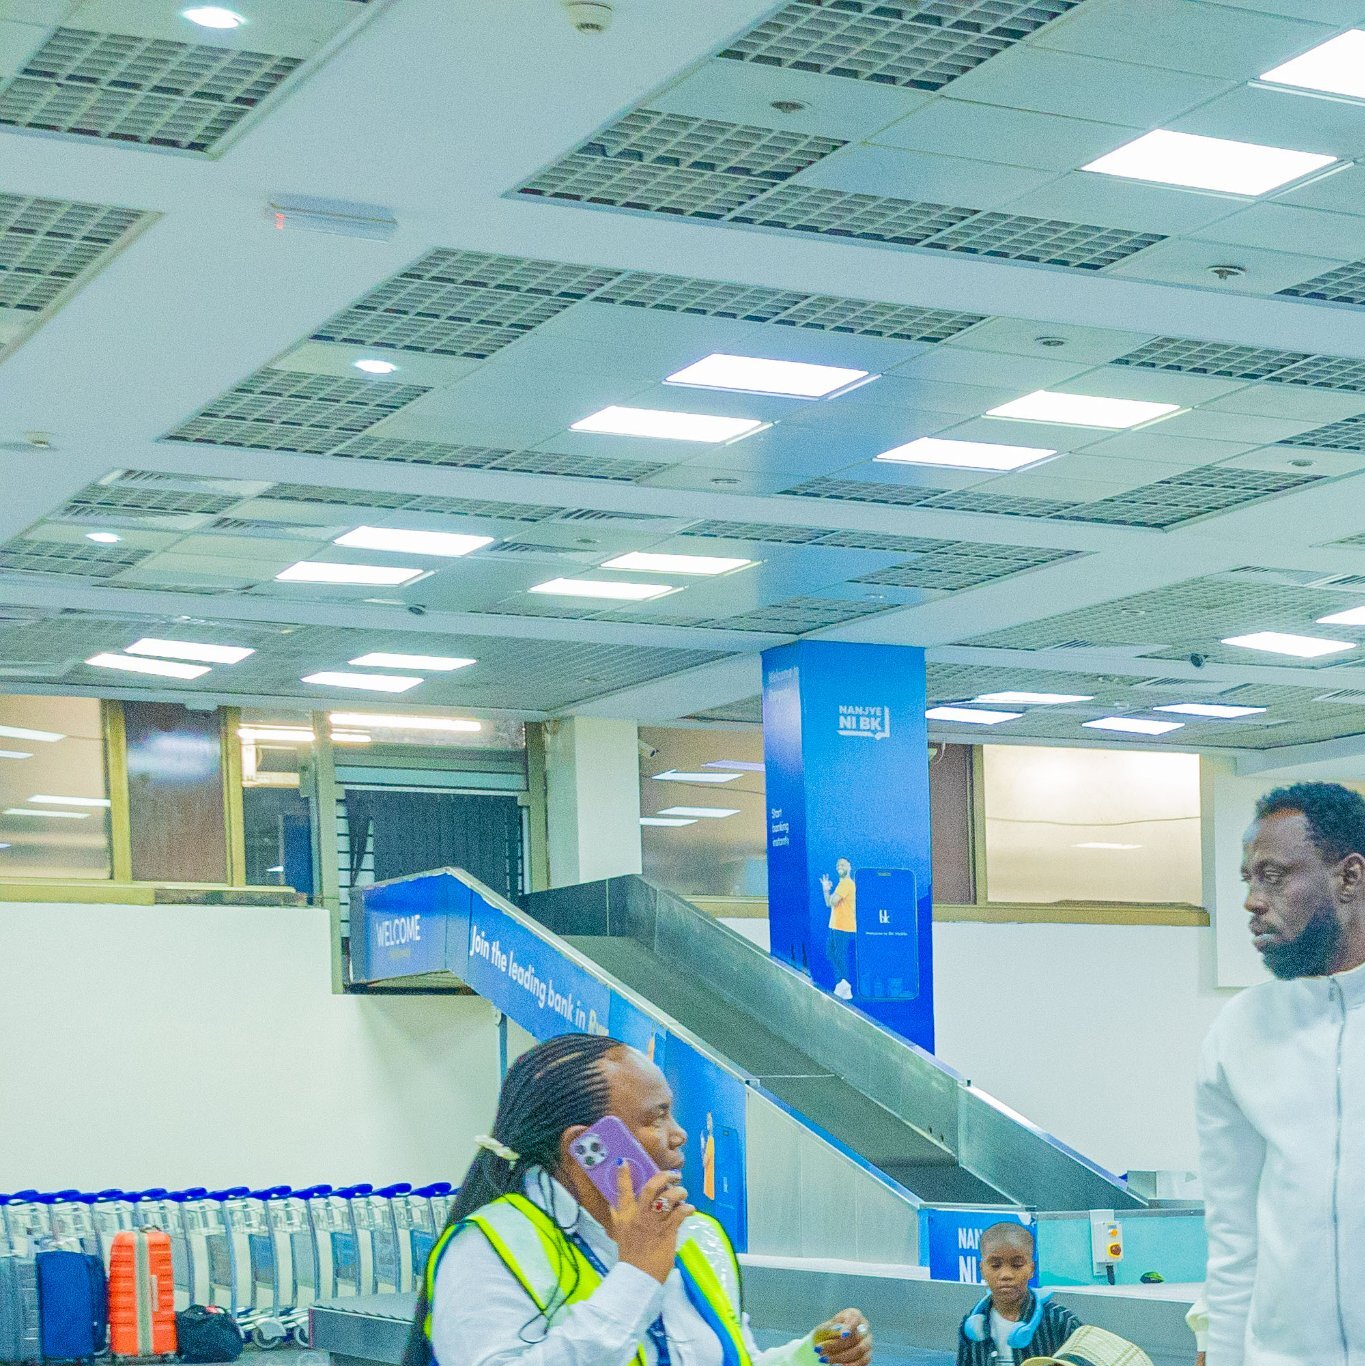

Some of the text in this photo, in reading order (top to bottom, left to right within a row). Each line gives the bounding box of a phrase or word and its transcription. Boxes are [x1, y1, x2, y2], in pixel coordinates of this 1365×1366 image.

[839, 704, 882, 716] NANJYE
[839, 716, 882, 731] NI BK
[376, 914, 421, 947] WELCOME
[469, 925, 490, 960] Join
[491, 940, 507, 972] the
[508, 951, 546, 1008] leading
[549, 979, 574, 1020] bank
[575, 1000, 586, 1031] in
